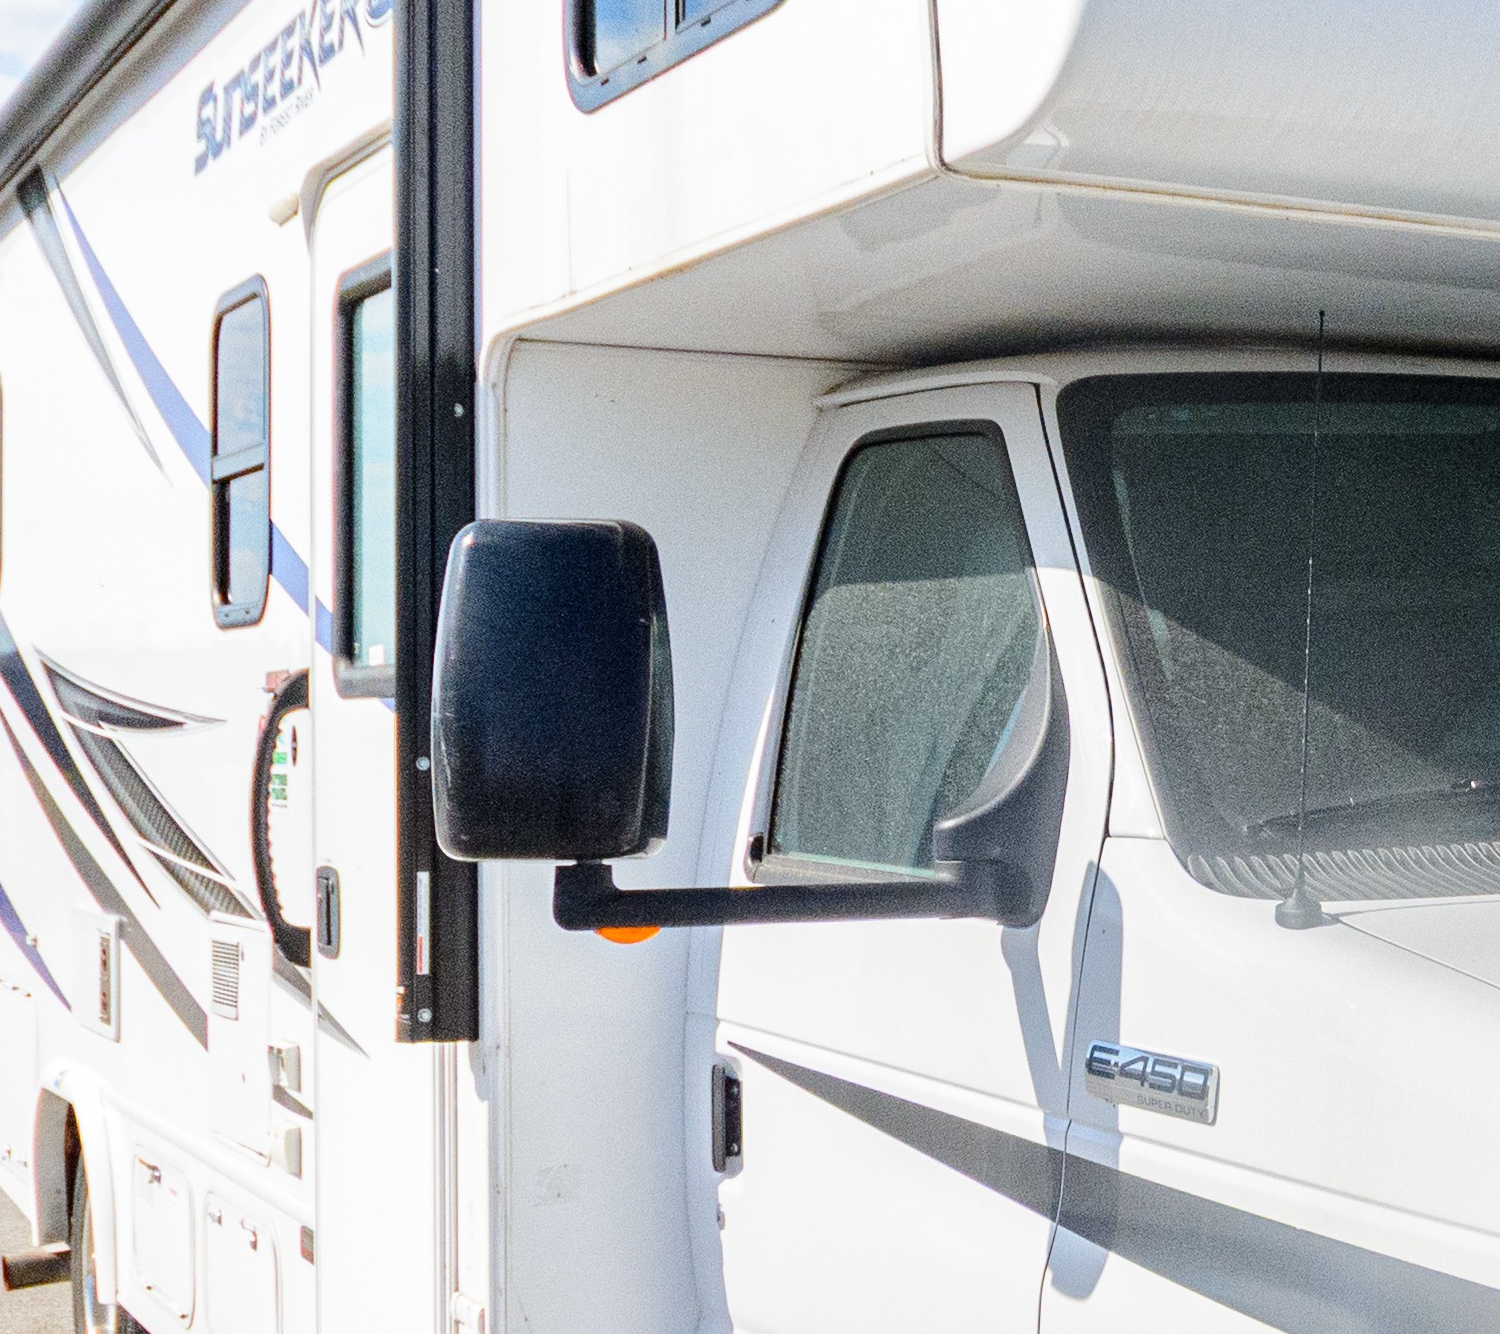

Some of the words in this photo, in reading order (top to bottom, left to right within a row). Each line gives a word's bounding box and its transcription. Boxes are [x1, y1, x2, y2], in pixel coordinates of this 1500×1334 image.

[1085, 1044, 1210, 1101] E-450
[1136, 1094, 1173, 1112] SUPER
[1174, 1103, 1205, 1117] DUTY
